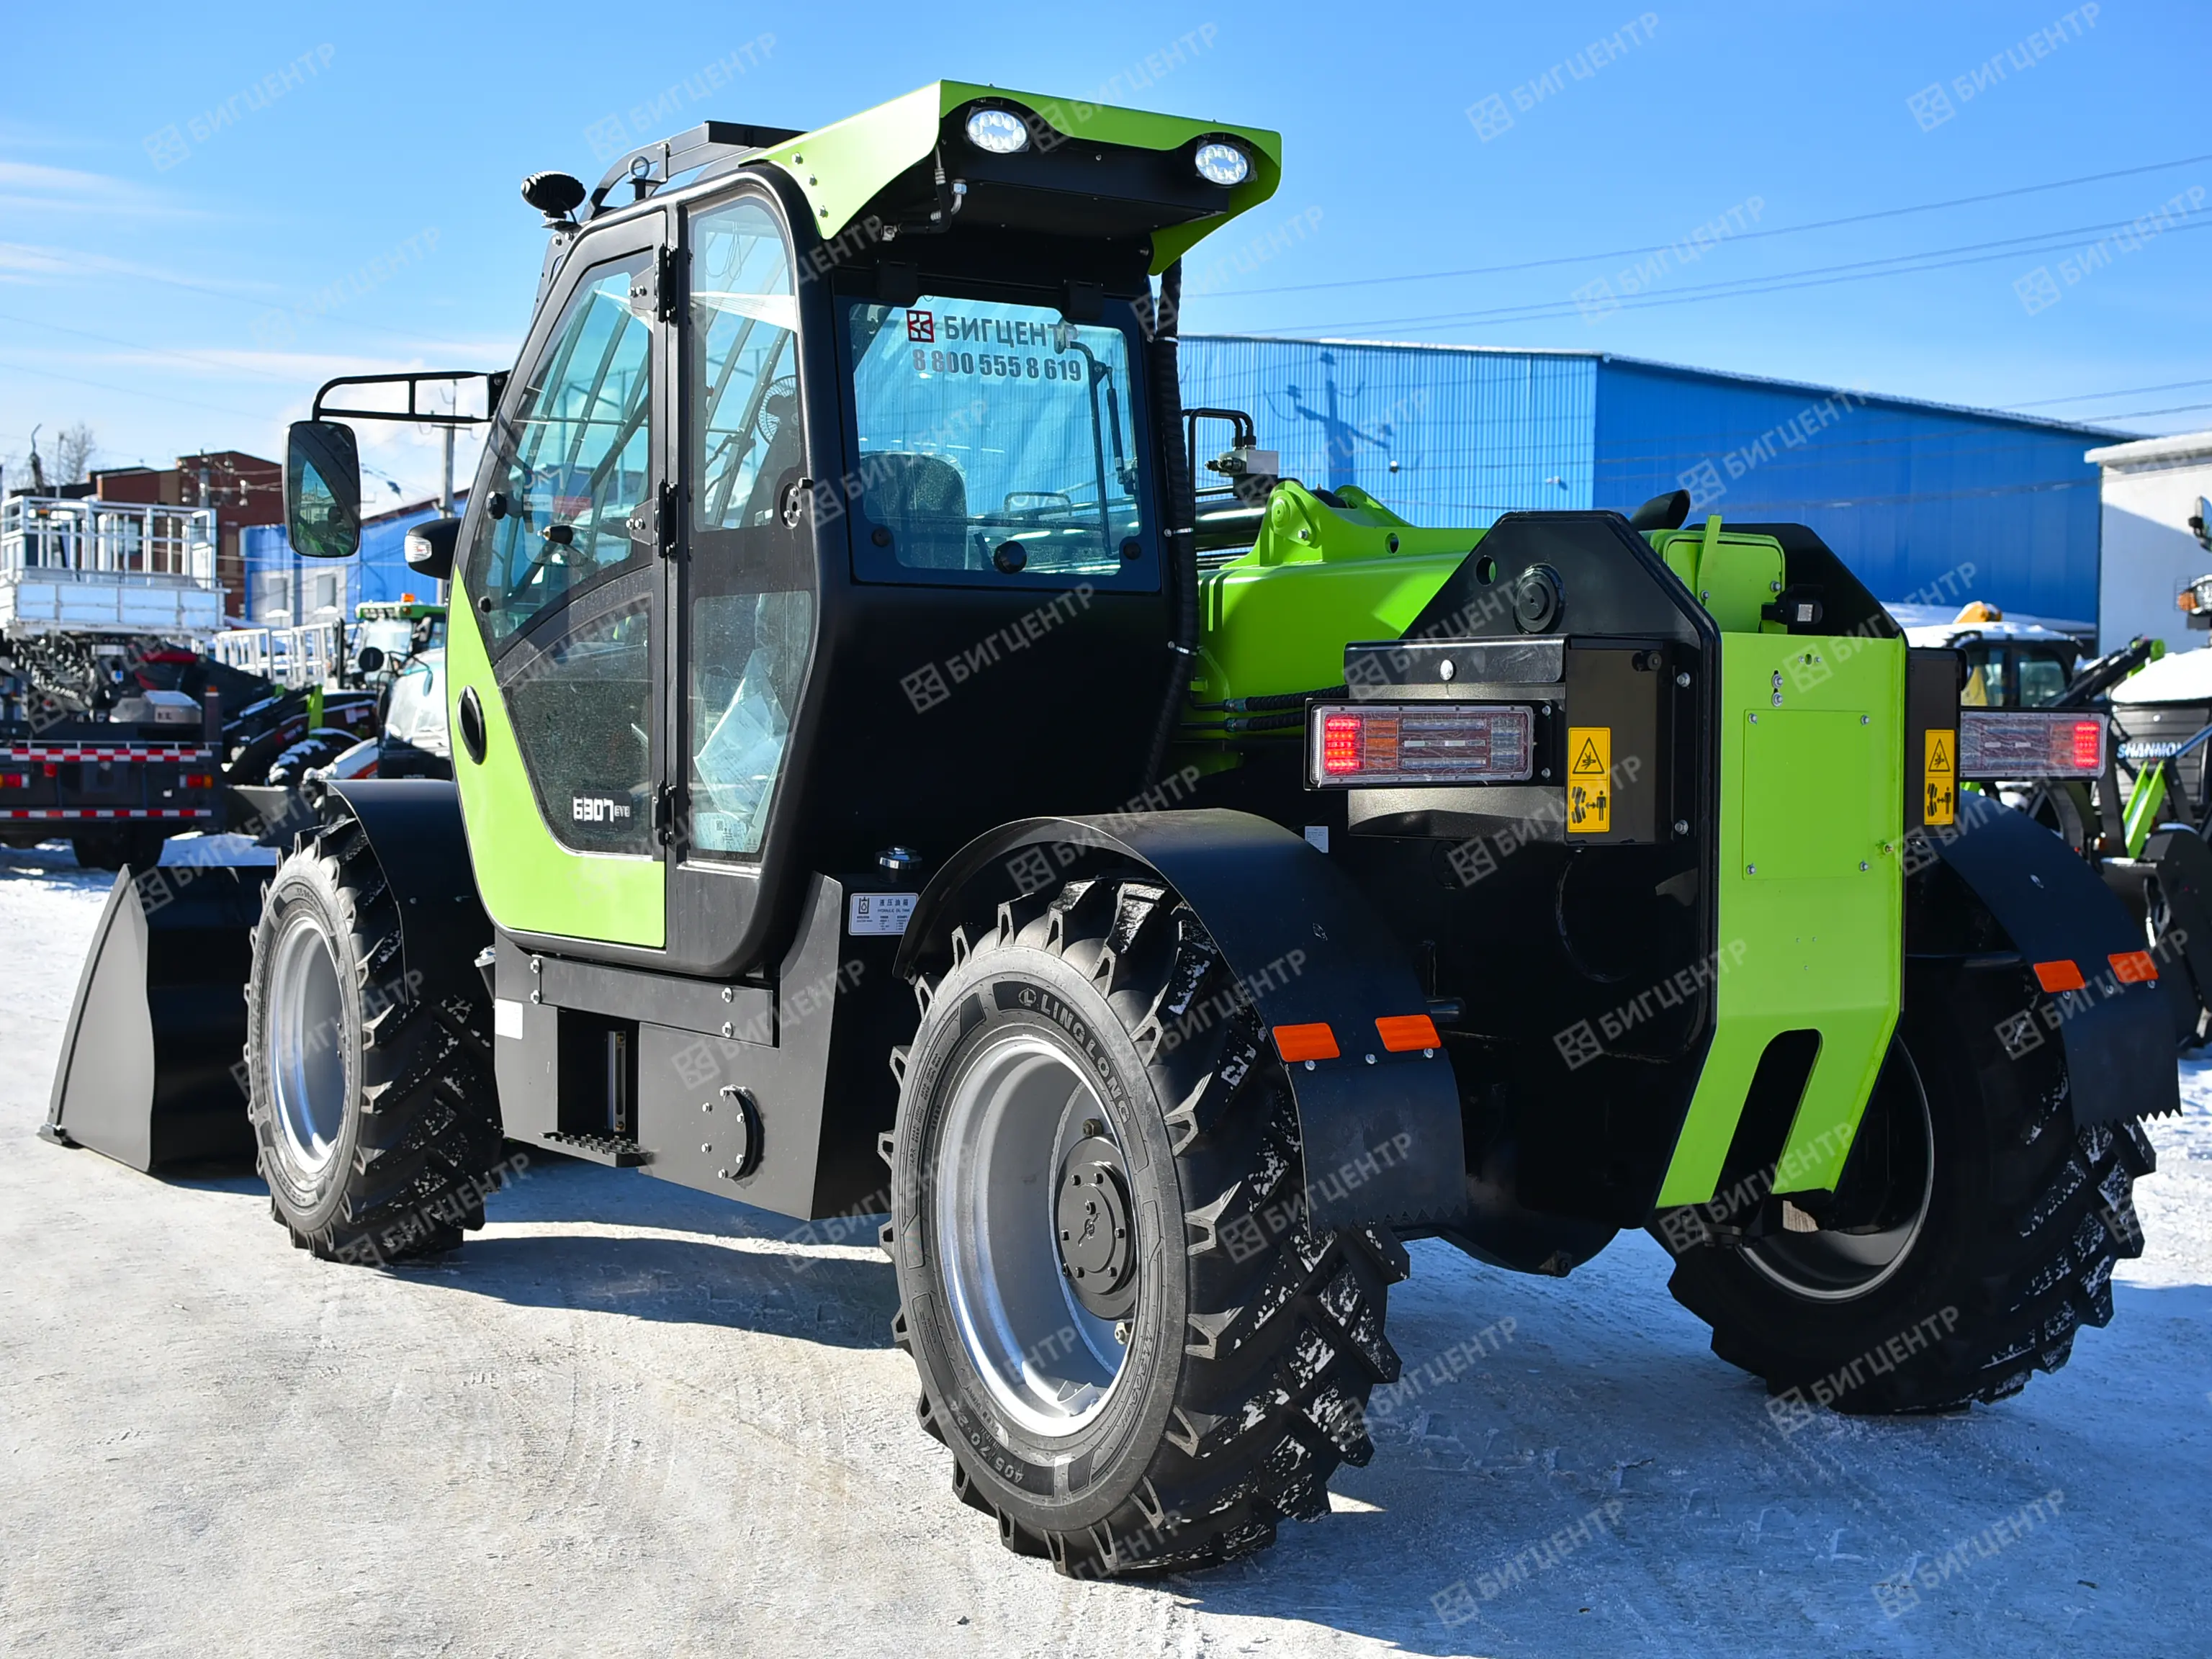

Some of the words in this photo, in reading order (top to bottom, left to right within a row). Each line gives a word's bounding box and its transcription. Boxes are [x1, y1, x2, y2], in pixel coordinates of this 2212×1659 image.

[943, 315, 1078, 349] БИГЦЕНТР
[912, 349, 925, 371] 8
[931, 350, 974, 374] 800
[979, 354, 1021, 377] 555
[1026, 356, 1039, 379] 8
[1044, 359, 1082, 381] 619
[572, 796, 614, 822] 6307
[1040, 994, 1130, 1123] LINGLONG
